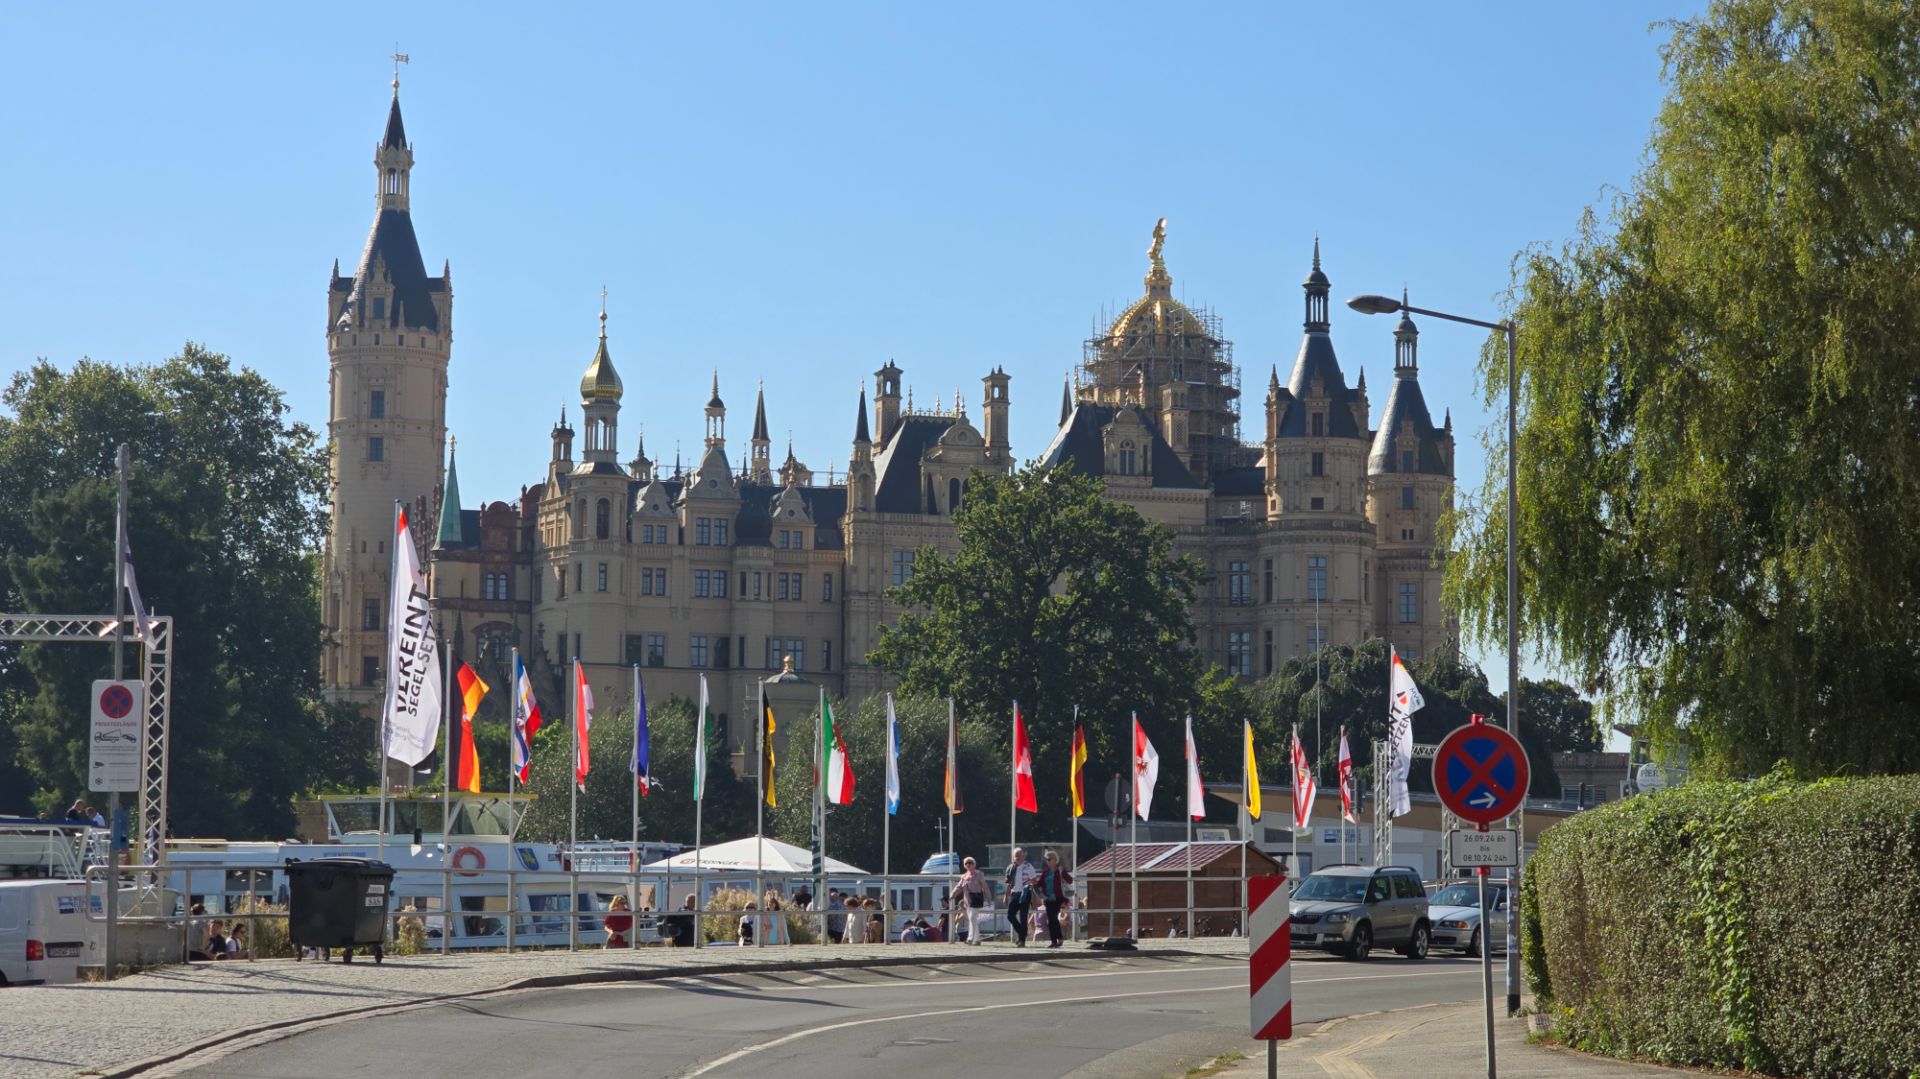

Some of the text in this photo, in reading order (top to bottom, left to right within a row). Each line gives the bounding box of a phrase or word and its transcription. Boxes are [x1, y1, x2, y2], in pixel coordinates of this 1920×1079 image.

[397, 583, 427, 712] VEREINT
[408, 612, 436, 717] SEGEL SETZ
[1463, 834, 1506, 843] 26.09.24 6h
[1463, 854, 1508, 862] 08.10.24 24h
